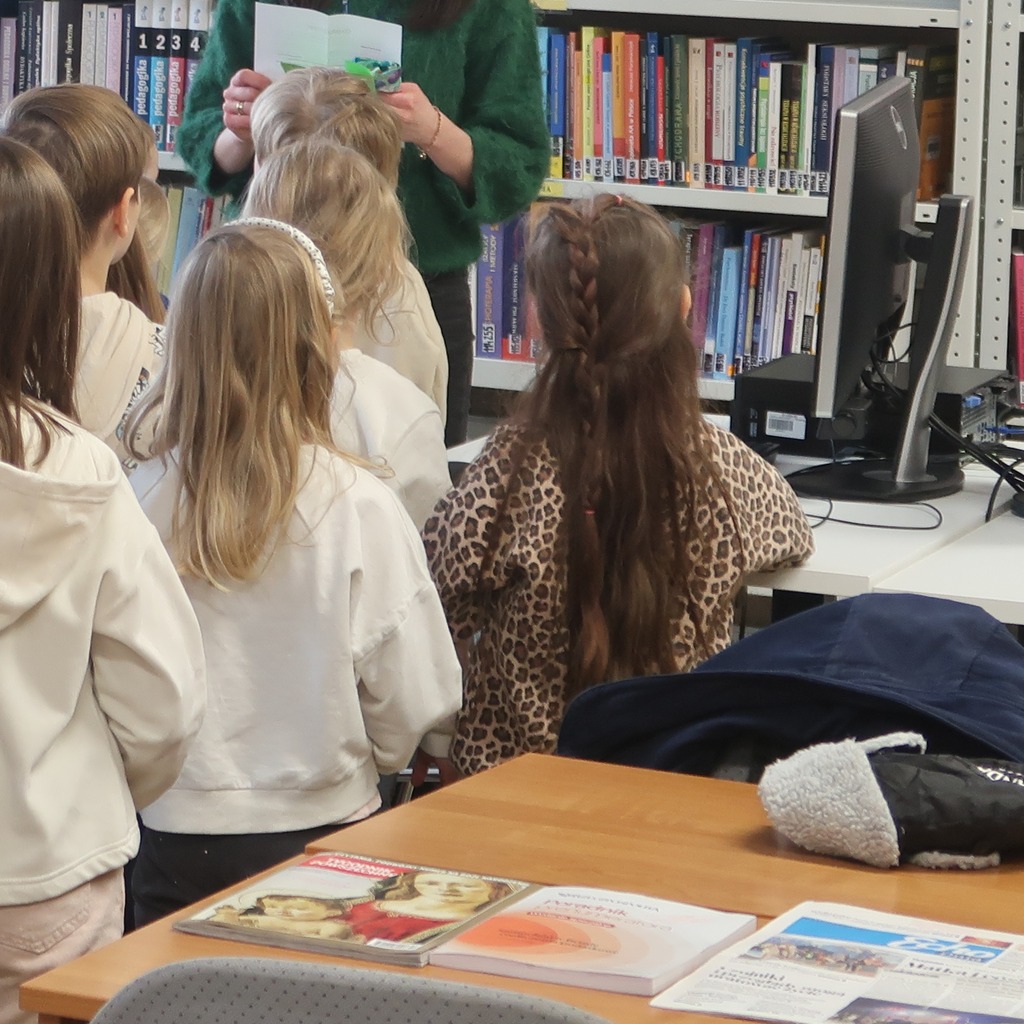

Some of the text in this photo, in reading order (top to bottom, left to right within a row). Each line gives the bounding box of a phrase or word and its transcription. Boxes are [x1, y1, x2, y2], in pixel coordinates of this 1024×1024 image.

[139, 34, 148, 49] 1
[156, 35, 165, 50] 2
[171, 35, 181, 49] 3
[189, 37, 200, 52] 4
[135, 59, 148, 115] pedagogika
[153, 60, 166, 117] pedagogika
[168, 61, 181, 117] pedagogika
[739, 49, 748, 90] Konsekwencje
[820, 100, 828, 141] SEKSUOLOGII
